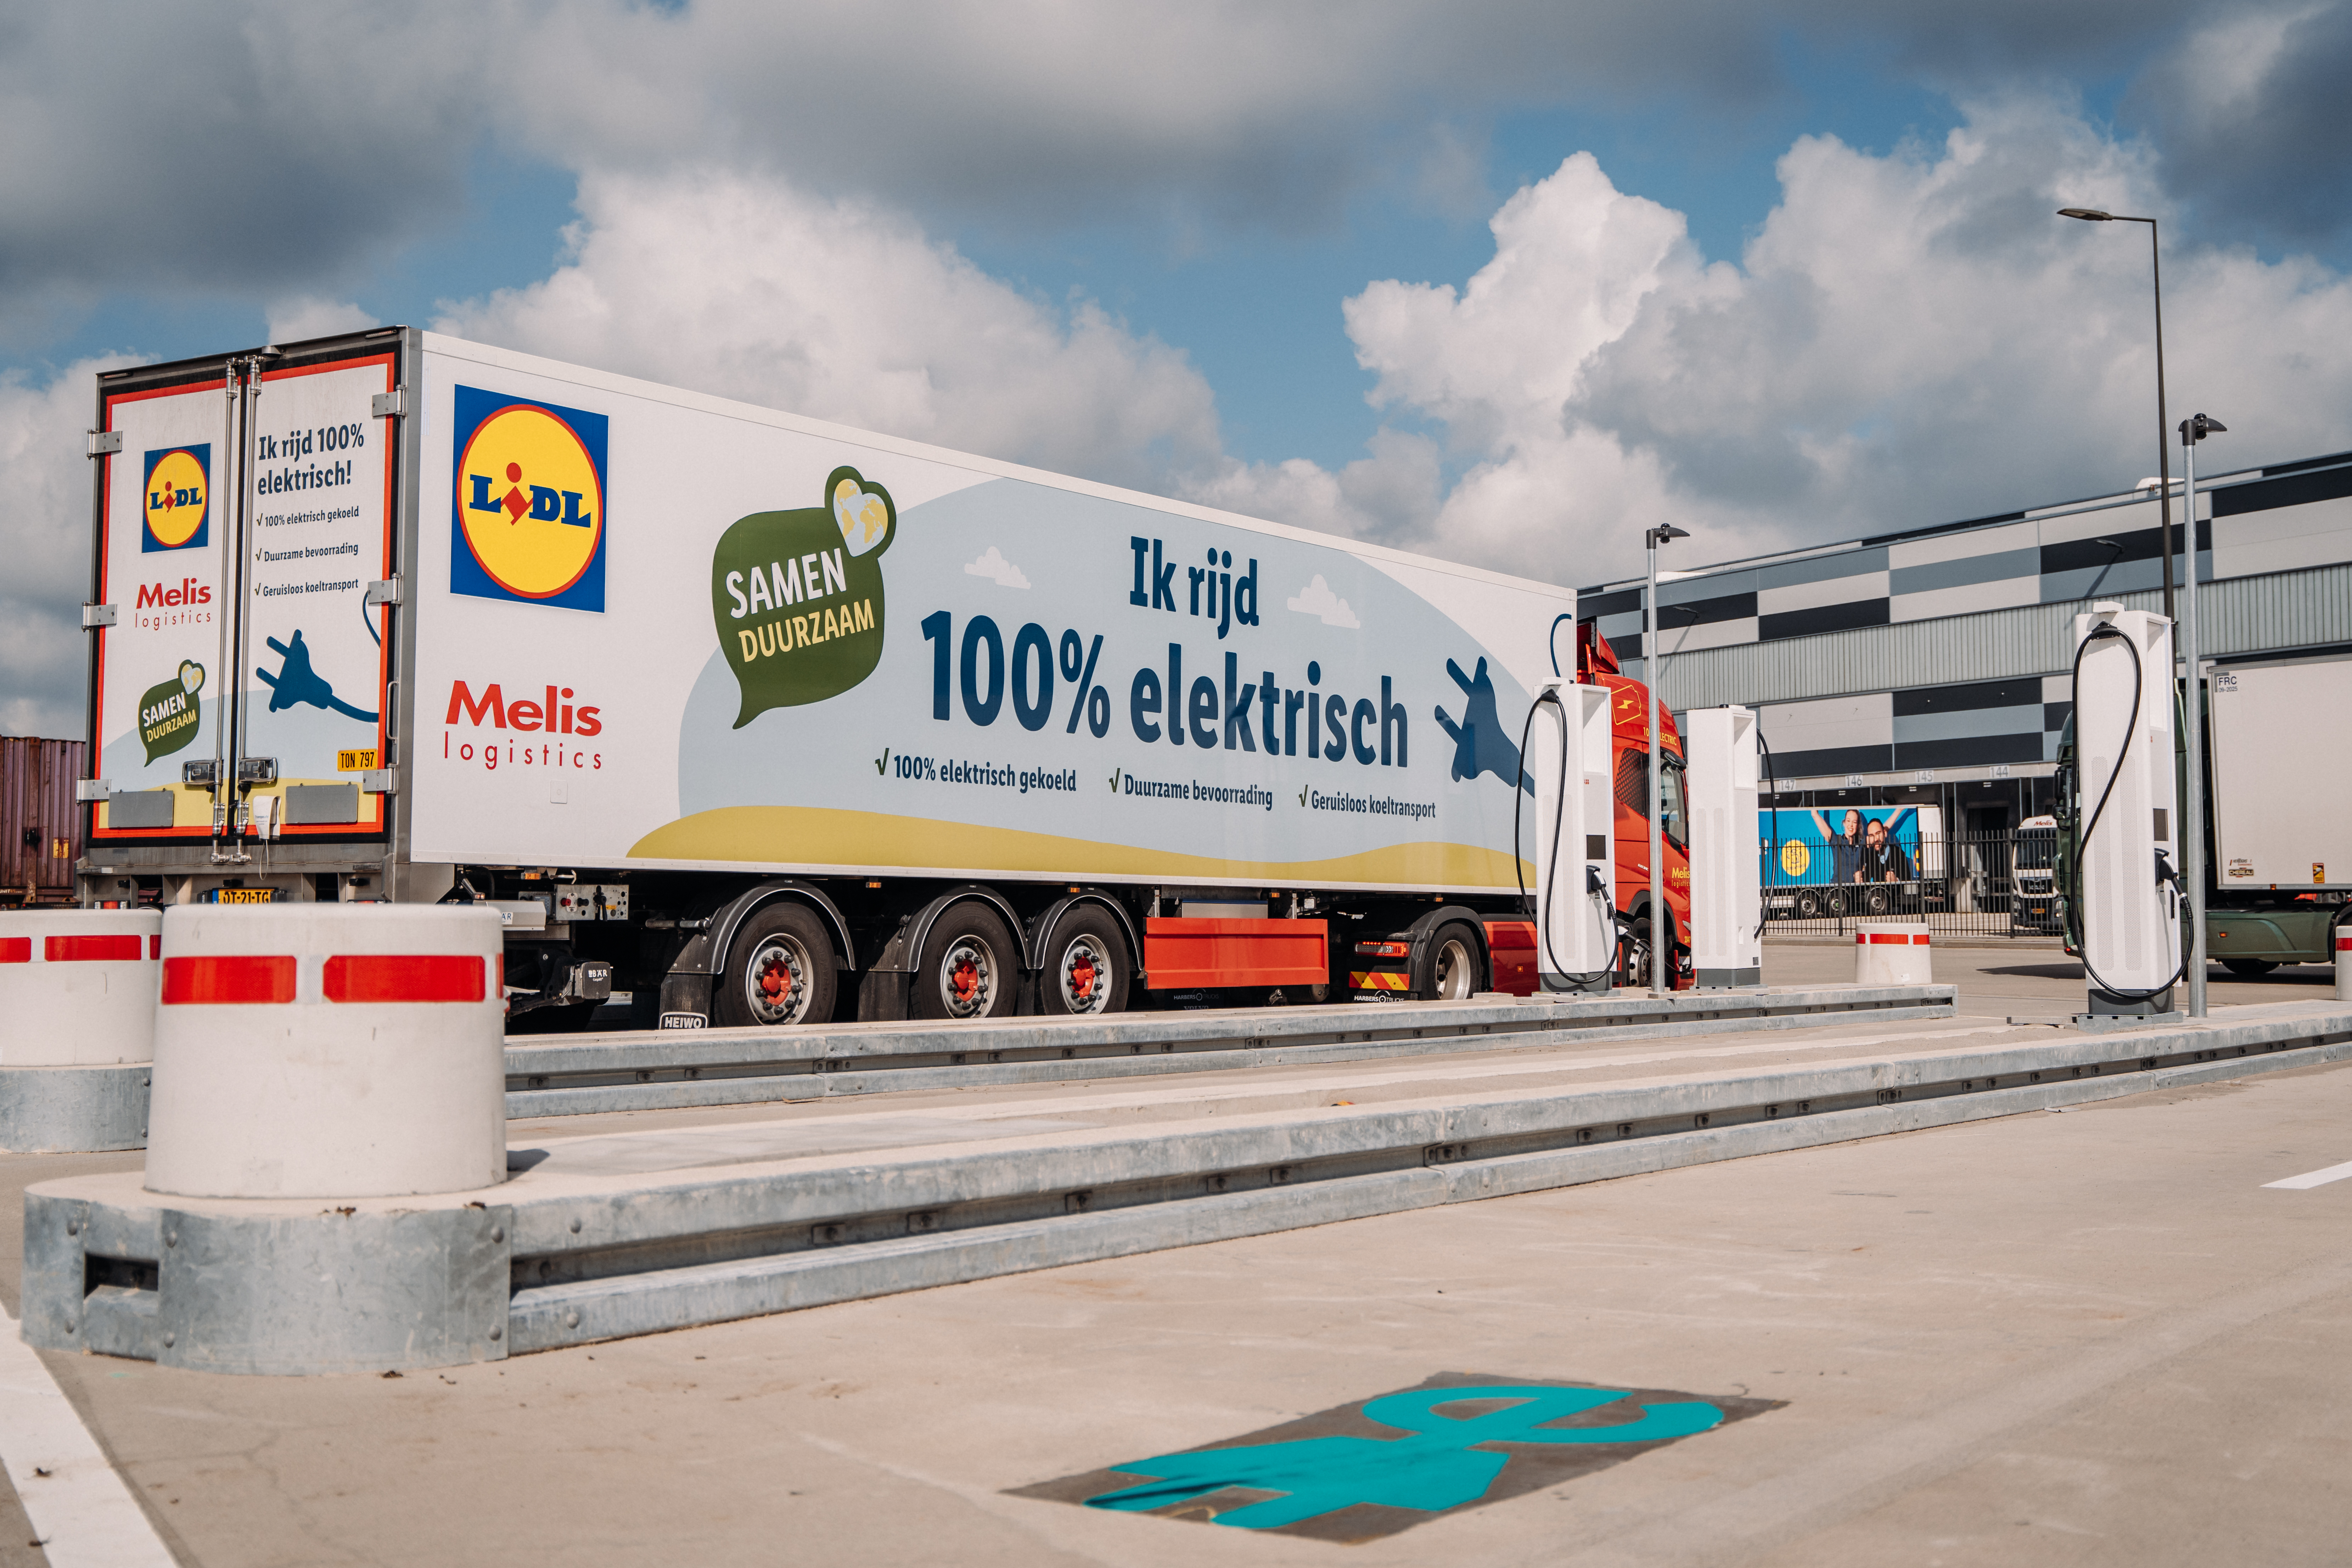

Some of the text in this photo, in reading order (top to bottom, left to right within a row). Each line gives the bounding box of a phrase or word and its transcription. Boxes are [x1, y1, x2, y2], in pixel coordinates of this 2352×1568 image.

[259, 423, 364, 461] Ik rijd 100%
[258, 460, 352, 495] elektrisch!
[265, 506, 359, 527] 100% elektrisch gekoeld
[264, 543, 358, 562] Duurzame bevoorrading
[136, 578, 211, 609] Melis
[263, 579, 358, 597] Geruisloos koeltransport
[726, 548, 847, 619] SAMEN
[1130, 536, 1259, 639] Ik rijd
[135, 610, 211, 631] logistics
[739, 599, 875, 662] DUURZAAM
[921, 611, 1408, 768] 100% elektrisch
[2219, 676, 2237, 686] FRC
[142, 692, 186, 726] SAMEN
[445, 680, 602, 736] Melis
[146, 710, 196, 742] DUURZAAM
[1660, 732, 1676, 746] LECTRIC
[341, 752, 375, 768] TON 797
[445, 731, 601, 770] logistics
[894, 755, 1076, 793] 100% elektrisch gekoeld
[1847, 776, 1862, 786] 146
[1916, 771, 1933, 782] 145
[1990, 767, 2008, 778] 144
[1125, 774, 1272, 811] Duurzame bevoorrading
[1780, 781, 1795, 791] 147
[1311, 790, 1436, 821] Geruisloos koeltransport
[1672, 867, 1690, 878] Melis
[1672, 879, 1690, 888] logistics
[665, 1017, 702, 1029] HEIWO
